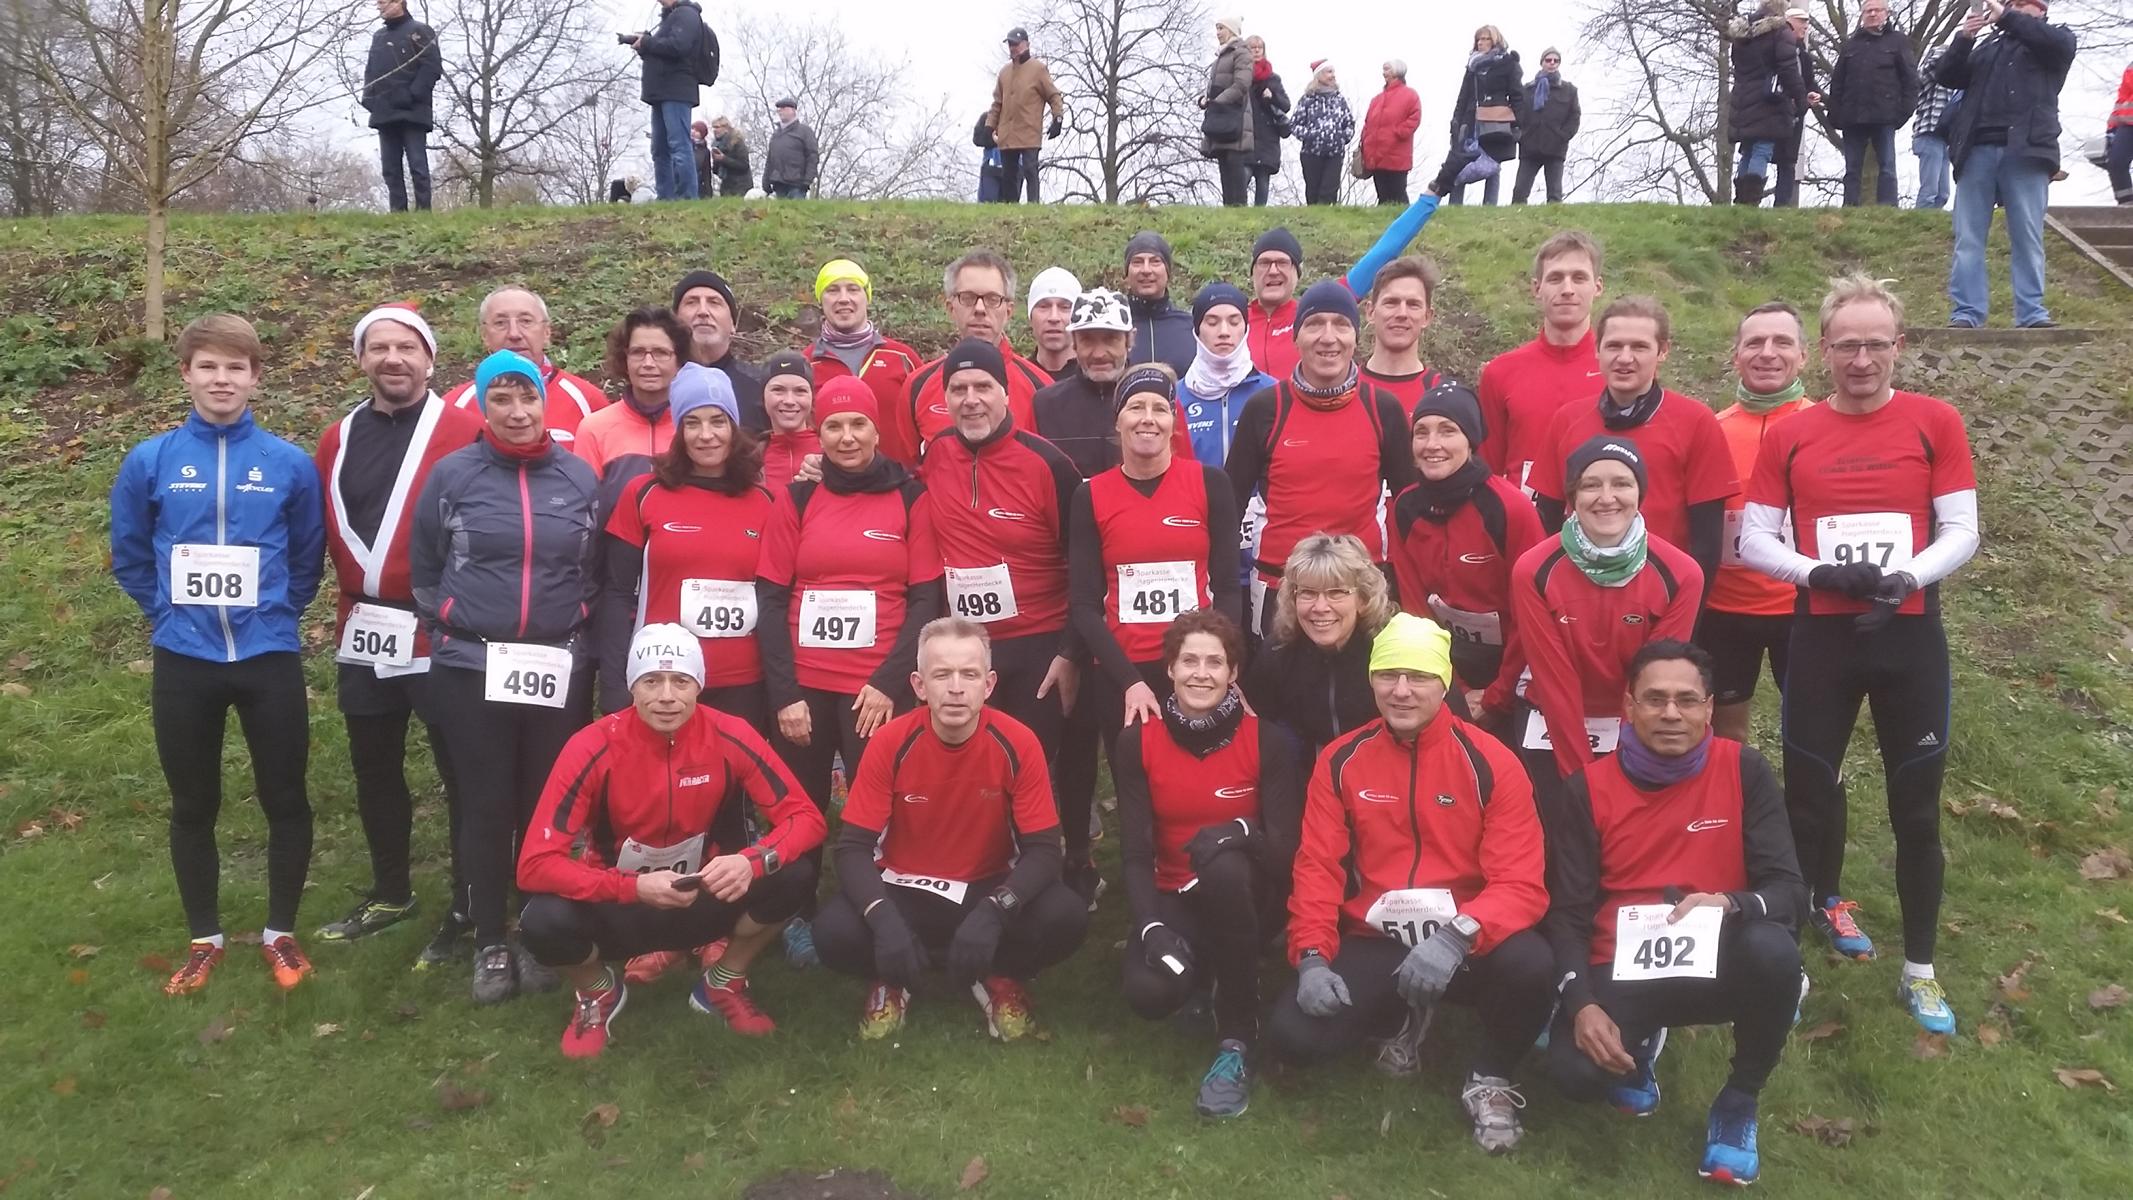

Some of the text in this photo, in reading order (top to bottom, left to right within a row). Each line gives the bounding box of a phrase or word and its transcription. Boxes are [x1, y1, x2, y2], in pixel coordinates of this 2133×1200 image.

[1834, 542, 1895, 568] 917
[186, 573, 242, 598] 508
[957, 592, 1001, 617] 498
[1133, 589, 1180, 615] 481
[696, 606, 744, 631] 493
[812, 617, 860, 641] 497
[352, 629, 397, 658] 504
[636, 645, 685, 660] VITAL
[503, 670, 557, 699] 496
[1633, 936, 1696, 970] 492
